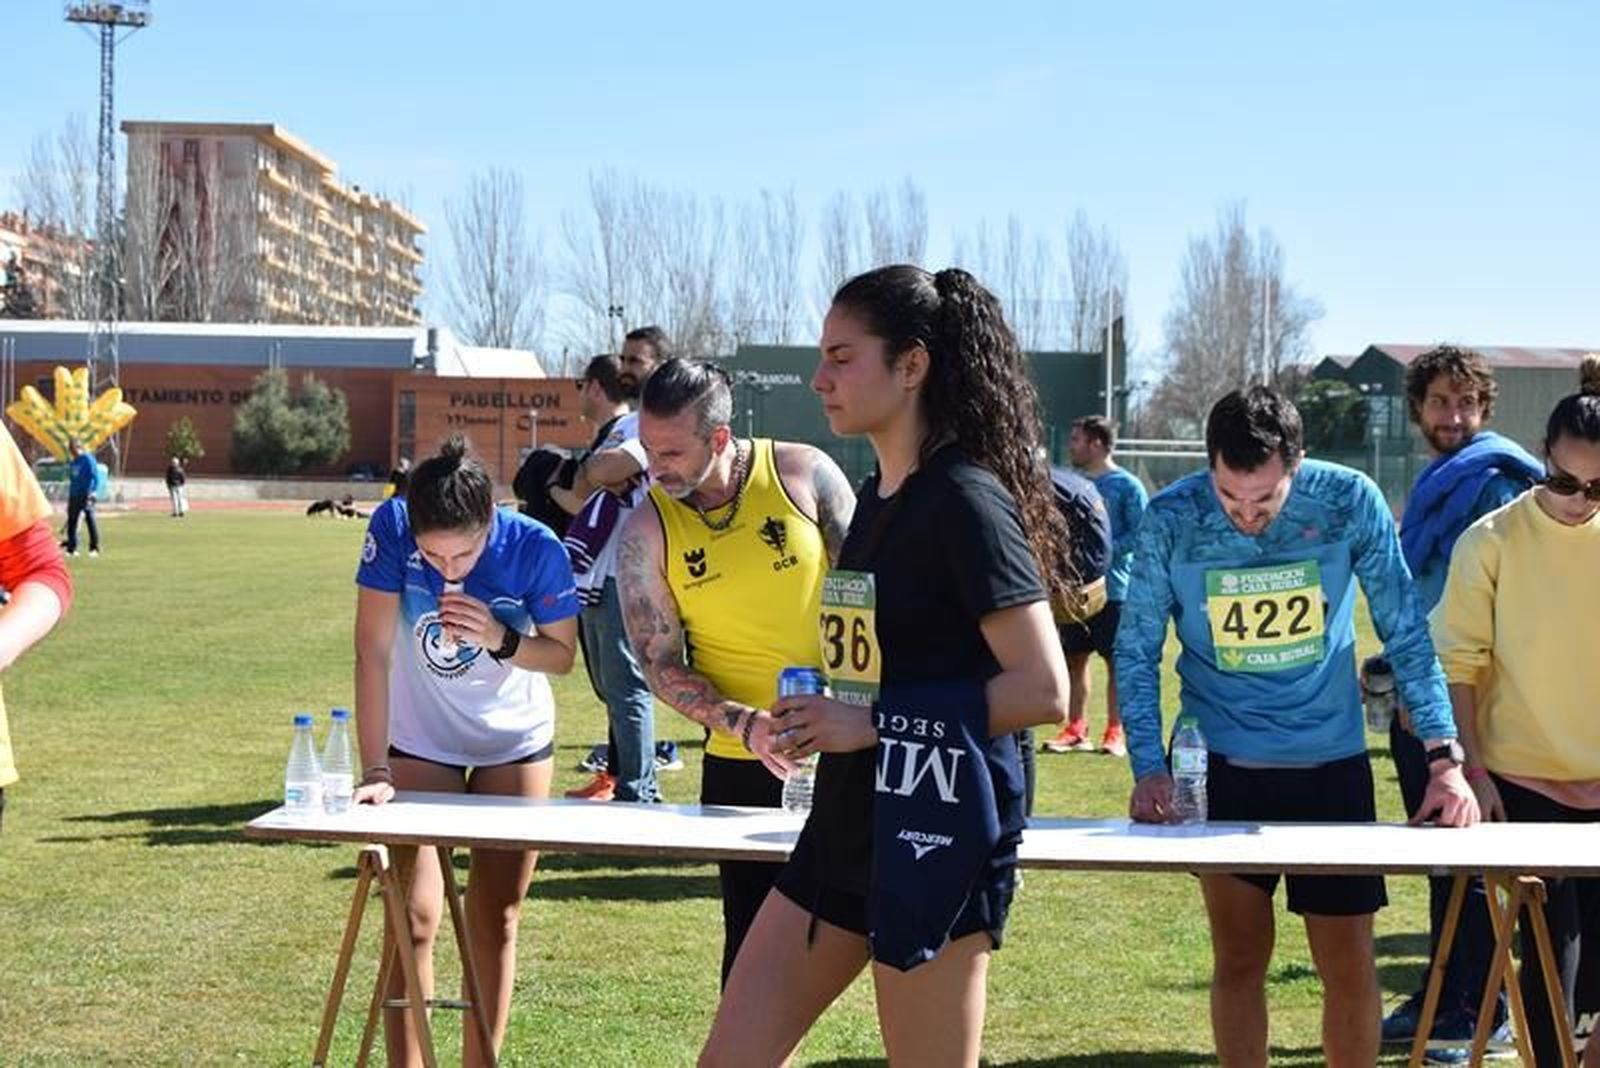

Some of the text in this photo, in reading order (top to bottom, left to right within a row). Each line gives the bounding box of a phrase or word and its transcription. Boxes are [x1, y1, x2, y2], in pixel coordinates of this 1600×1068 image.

[122, 388, 225, 405] TAMIENTO
[450, 392, 561, 409] PABELLON
[1222, 595, 1313, 641] 422
[820, 612, 870, 673] 36
[896, 828, 954, 848] MERCURY
